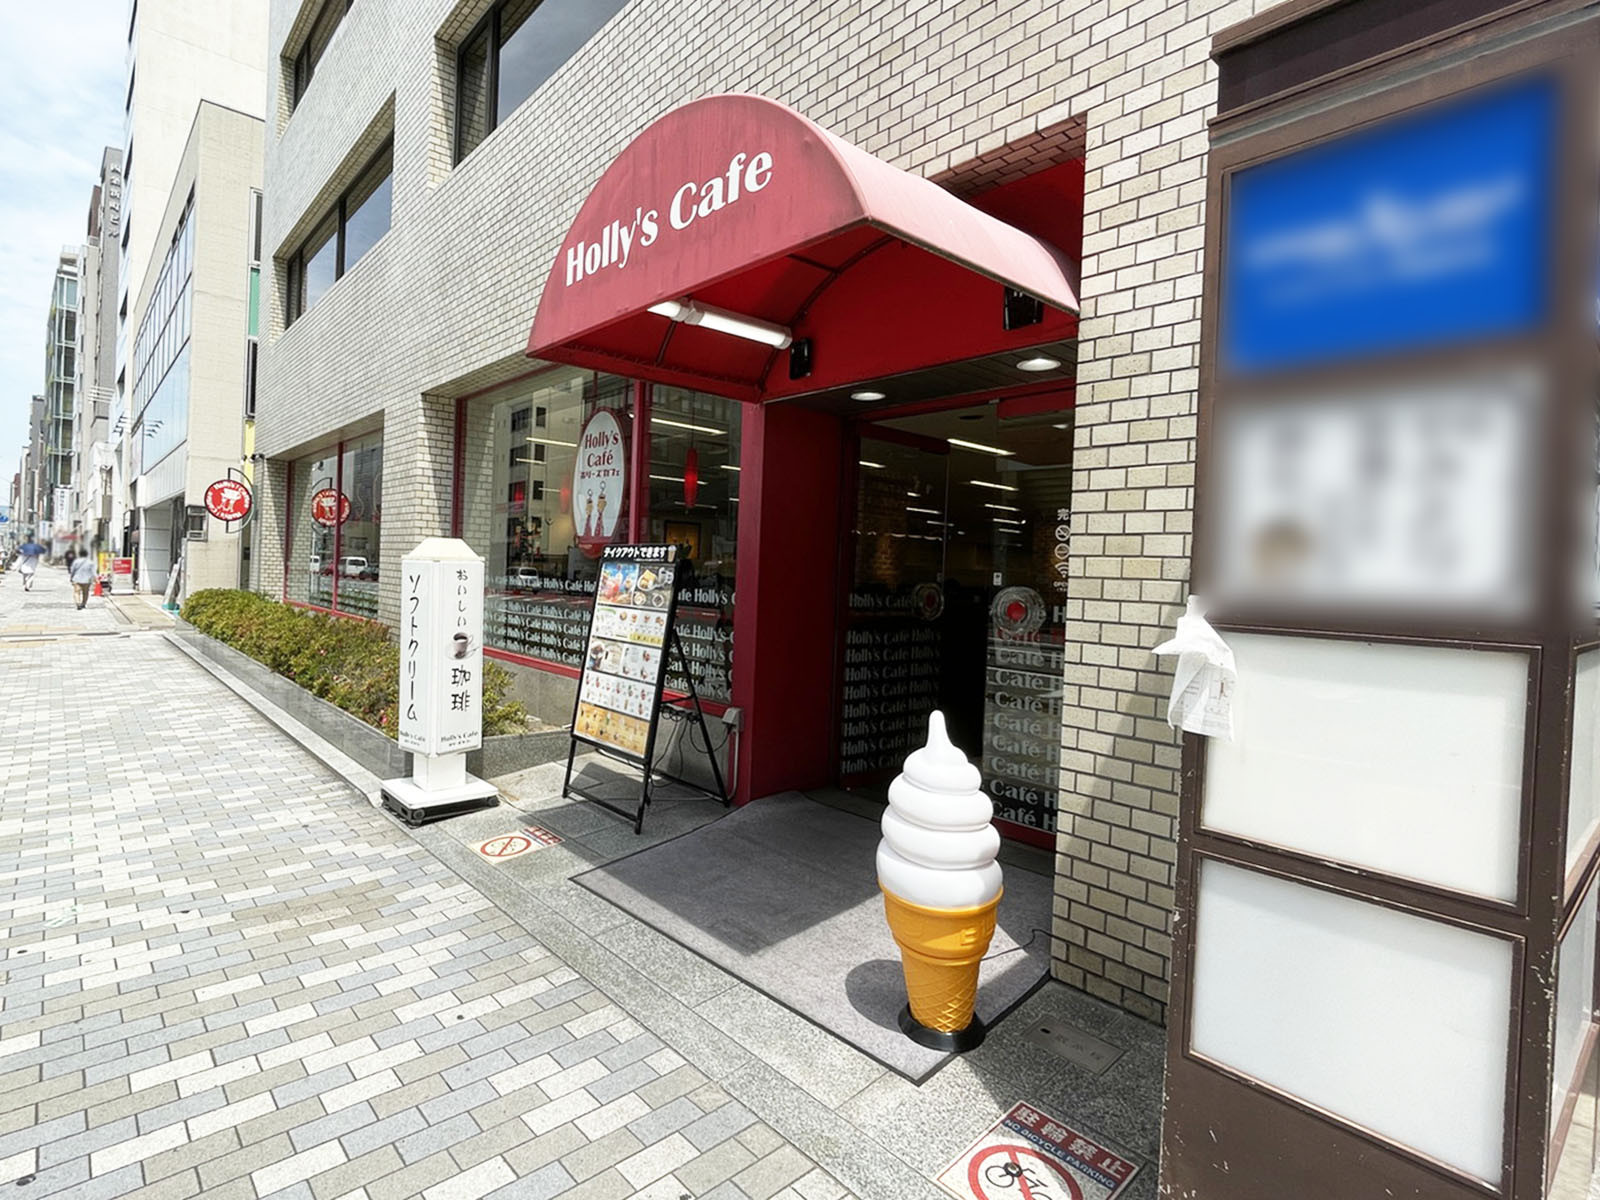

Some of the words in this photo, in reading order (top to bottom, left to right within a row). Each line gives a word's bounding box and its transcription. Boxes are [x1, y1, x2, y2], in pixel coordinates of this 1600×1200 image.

[566, 207, 658, 287] Holly's
[669, 152, 773, 230] Cafe
[585, 430, 619, 449] Holly's
[587, 450, 614, 468] Café
[603, 546, 667, 559] テイクアウトできます
[456, 569, 469, 627] おいしい
[694, 588, 728, 607] Holly's
[693, 624, 727, 643] Holly's
[847, 629, 881, 645] Holly's
[406, 574, 421, 721] ソフトクリーム
[692, 642, 725, 661] Holly's
[846, 647, 881, 663] Holly's
[691, 661, 725, 680] Holly's
[845, 665, 880, 681] Holly's
[451, 664, 472, 712] 珈琲
[664, 673, 689, 690] Café
[845, 683, 879, 701] Holly's
[844, 702, 879, 719] Holly's
[844, 719, 878, 737] Holly's
[991, 757, 1040, 780] Café
[990, 779, 1039, 805] Café
[1014, 1106, 1126, 1180] 駐輪禁止
[1003, 1118, 1021, 1132] NO
[1020, 1128, 1066, 1157] BICYCLE
[1066, 1155, 1116, 1190] PARKING
